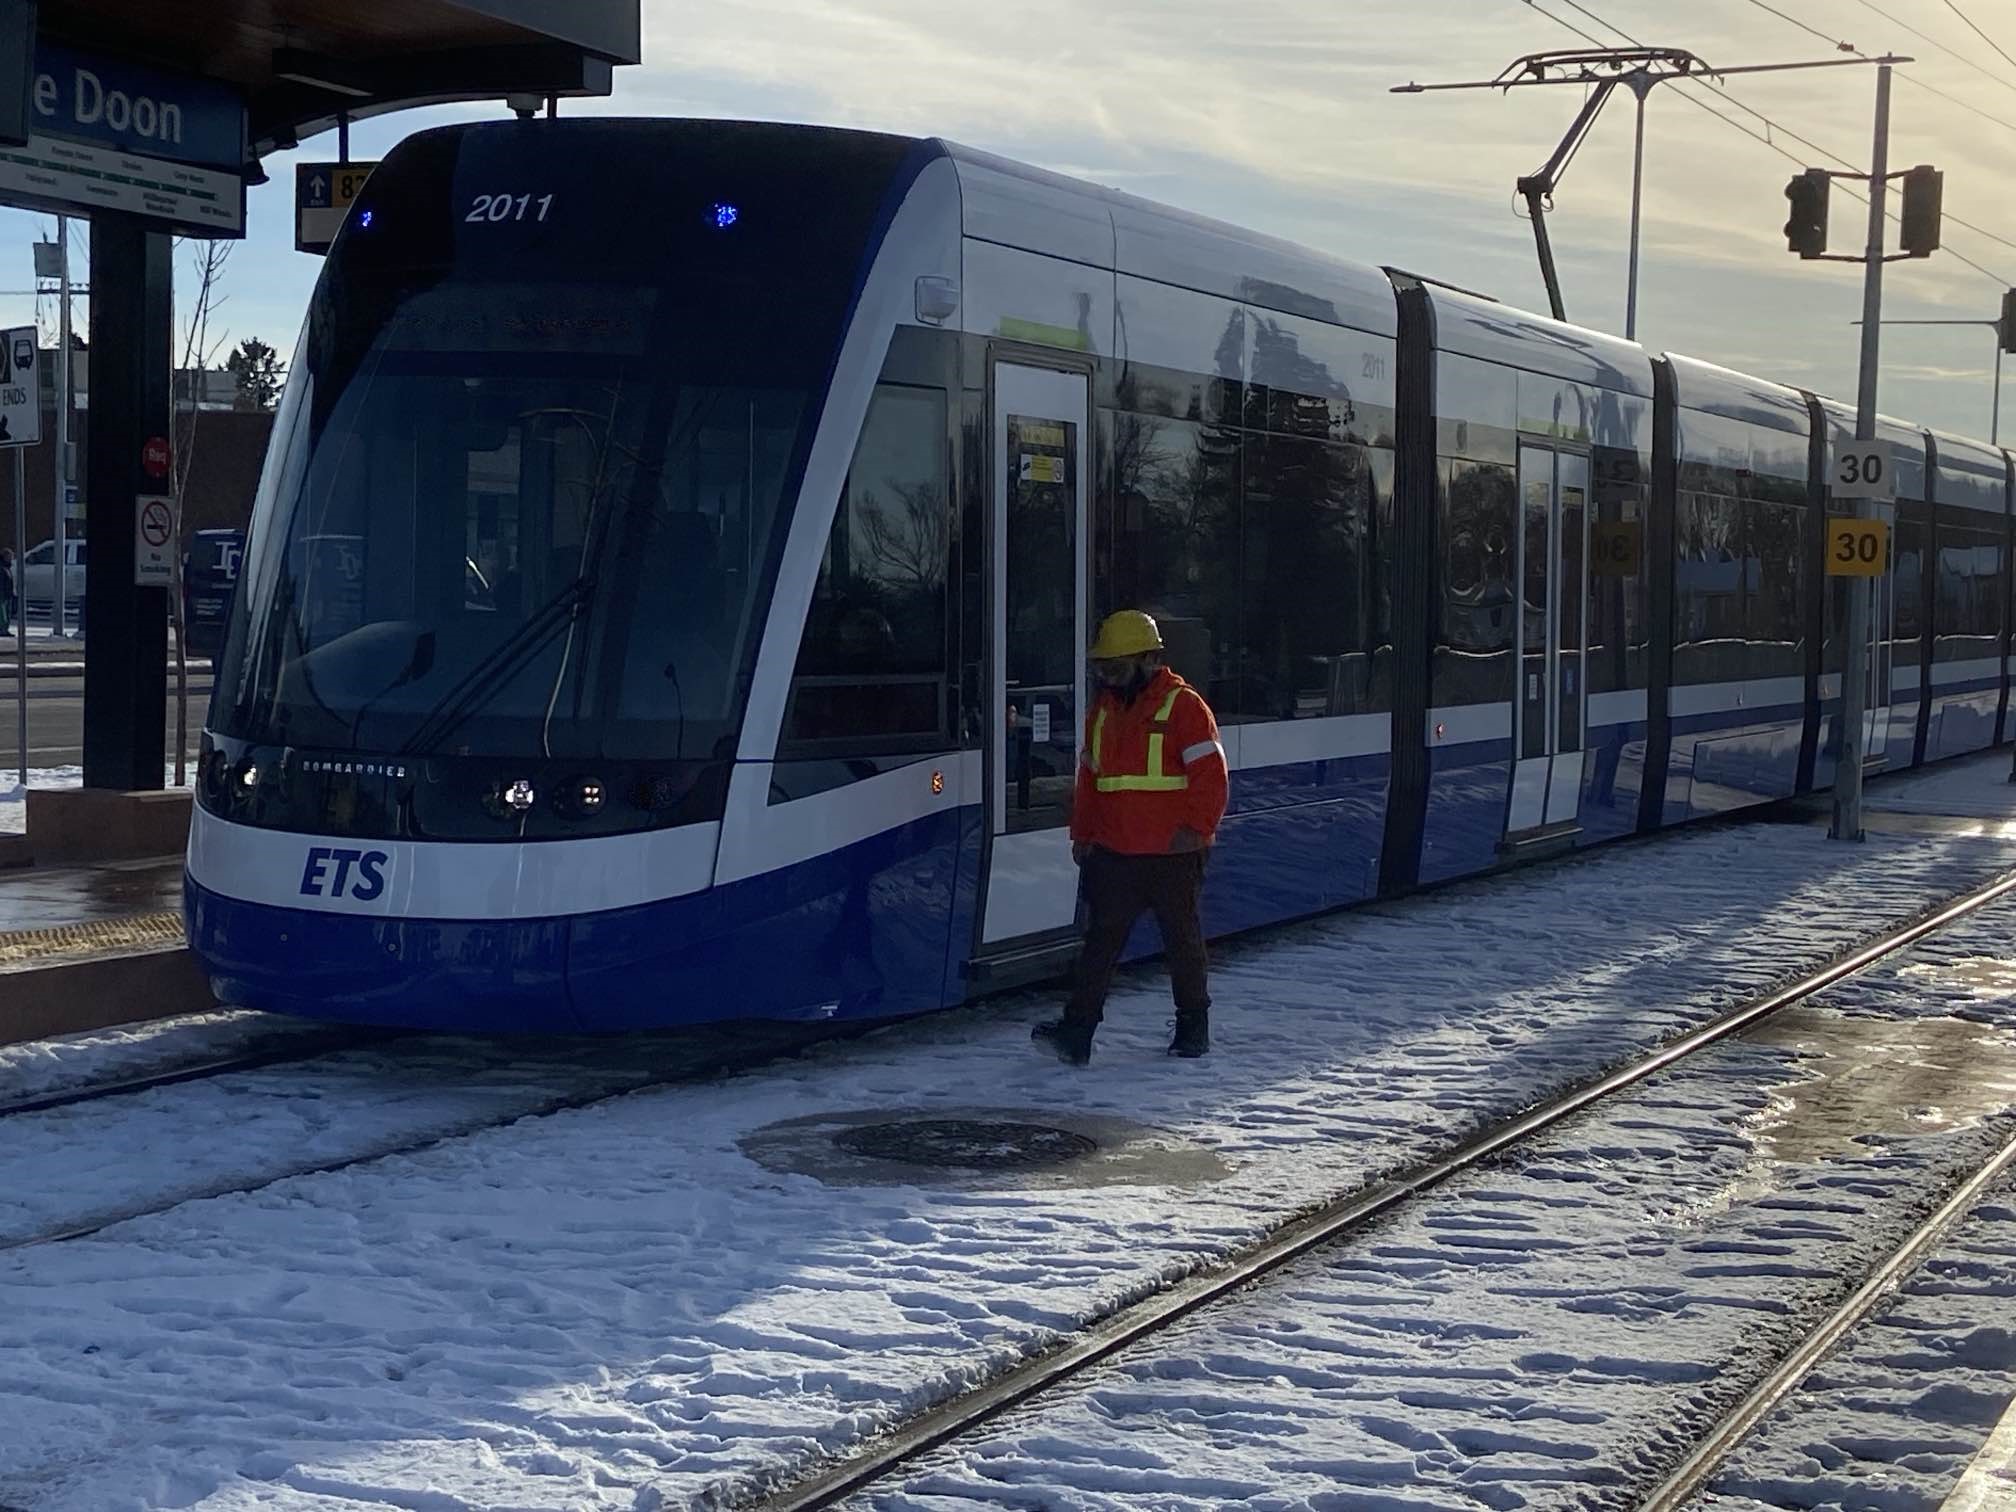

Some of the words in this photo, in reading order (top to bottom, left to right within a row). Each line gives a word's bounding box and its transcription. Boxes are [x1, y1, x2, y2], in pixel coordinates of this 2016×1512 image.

[75, 68, 181, 144] Doon
[464, 193, 553, 222] 2011
[1361, 352, 1385, 380] 2011
[3, 387, 26, 406] ENDS
[1839, 454, 1882, 484] 30
[1835, 532, 1878, 562] 30
[303, 760, 406, 778] BOMBARDIER
[300, 847, 388, 901] ETS
